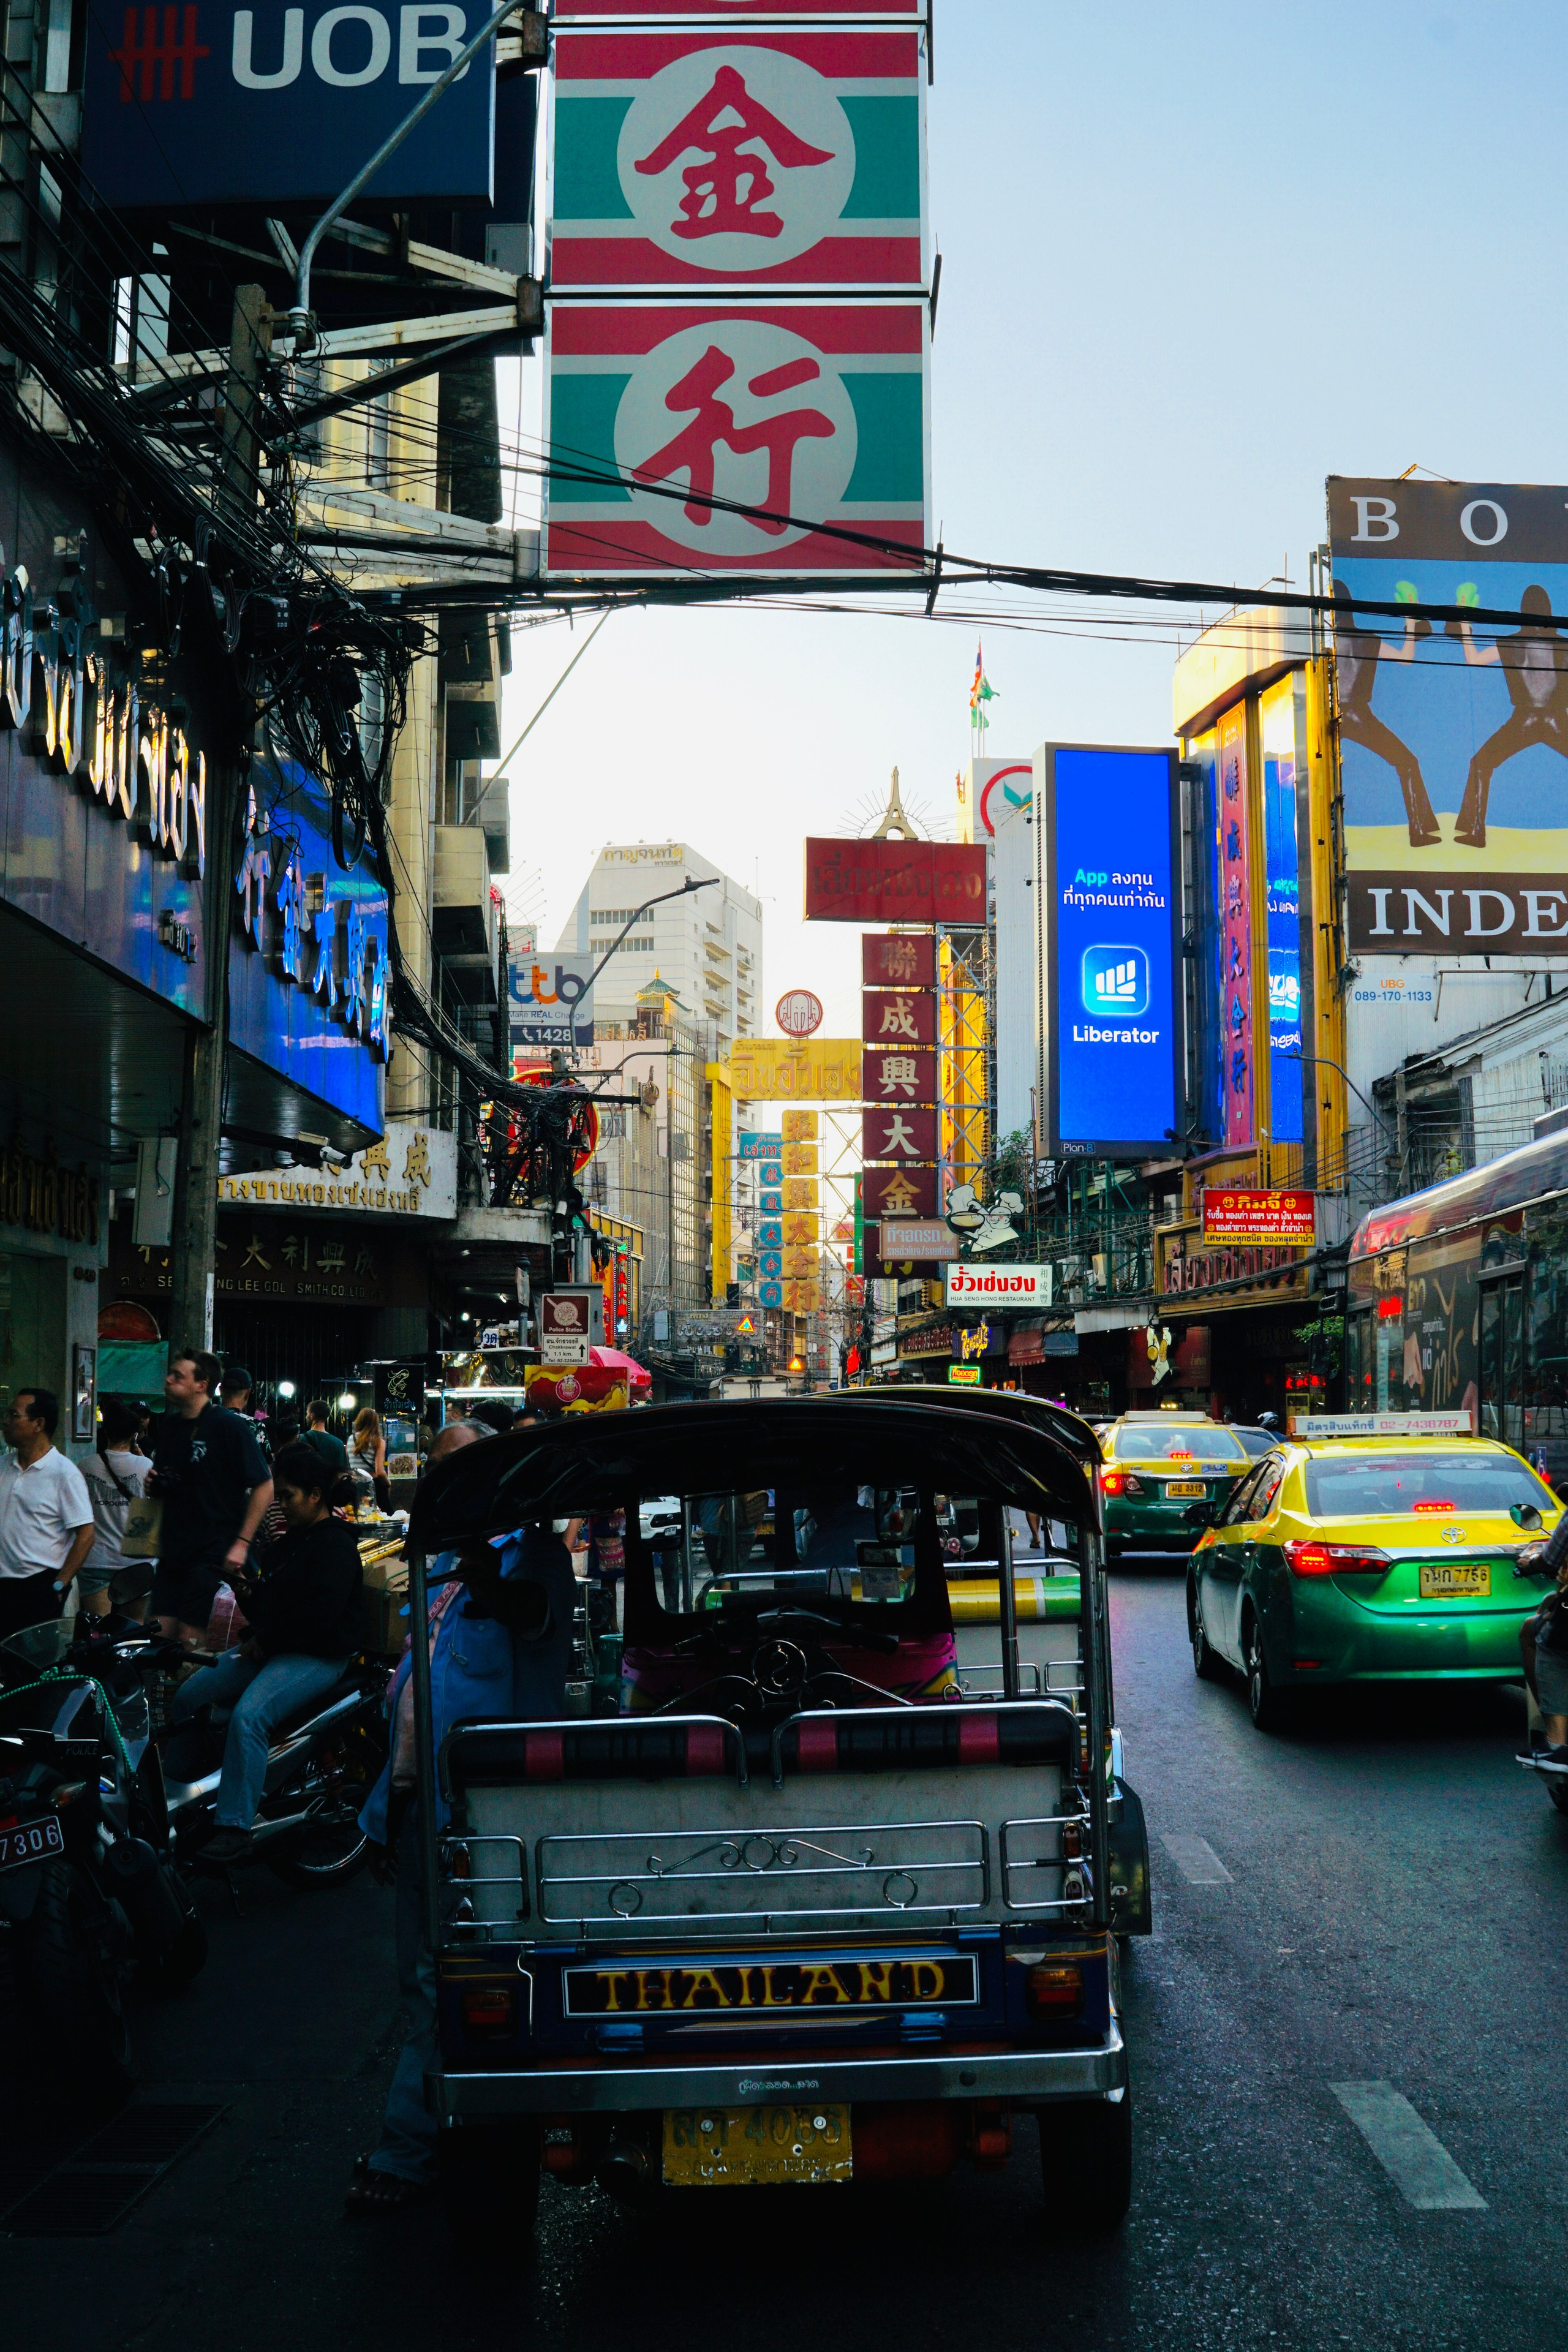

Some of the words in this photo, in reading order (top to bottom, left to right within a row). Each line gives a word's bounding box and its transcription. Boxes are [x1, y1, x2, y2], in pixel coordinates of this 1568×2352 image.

[232, 3, 471, 89] UOB
[604, 843, 683, 864] กาญจนทัต
[1075, 869, 1107, 887] App
[1112, 873, 1153, 891] ลงทุน
[1063, 885, 1165, 911] ที่ทุกคนเท่ากัน
[508, 964, 586, 1005] ttb
[1380, 978, 1405, 989] UBG
[1354, 990, 1432, 1002] 089-170-1133
[536, 1028, 572, 1042] 1428
[1073, 1025, 1159, 1044] Liberator
[1207, 1207, 1224, 1219] รับซื้อ
[1226, 1210, 1248, 1219] ทองเก่า
[1281, 1210, 1292, 1220] เงิน
[1216, 1221, 1246, 1231] ทองคำขาว
[1248, 1222, 1279, 1232] พระทองคำ
[1207, 1233, 1262, 1245] เศษทองทุกชนิด
[1264, 1234, 1313, 1245] ของหลุดจำนำ
[238, 1279, 260, 1292] LEE
[951, 1265, 1036, 1292] ฮั่วเซ่งฮง
[1306, 1417, 1375, 1431] มิตรสิบแท็กซี่
[1380, 1419, 1459, 1430] 02-7438787
[1454, 1567, 1487, 1582] 7756
[442, 1583, 456, 1599] FILA
[428, 1601, 442, 1618] FILA
[66, 1744, 98, 1755] POLICE
[595, 1961, 946, 2011] THAILAND
